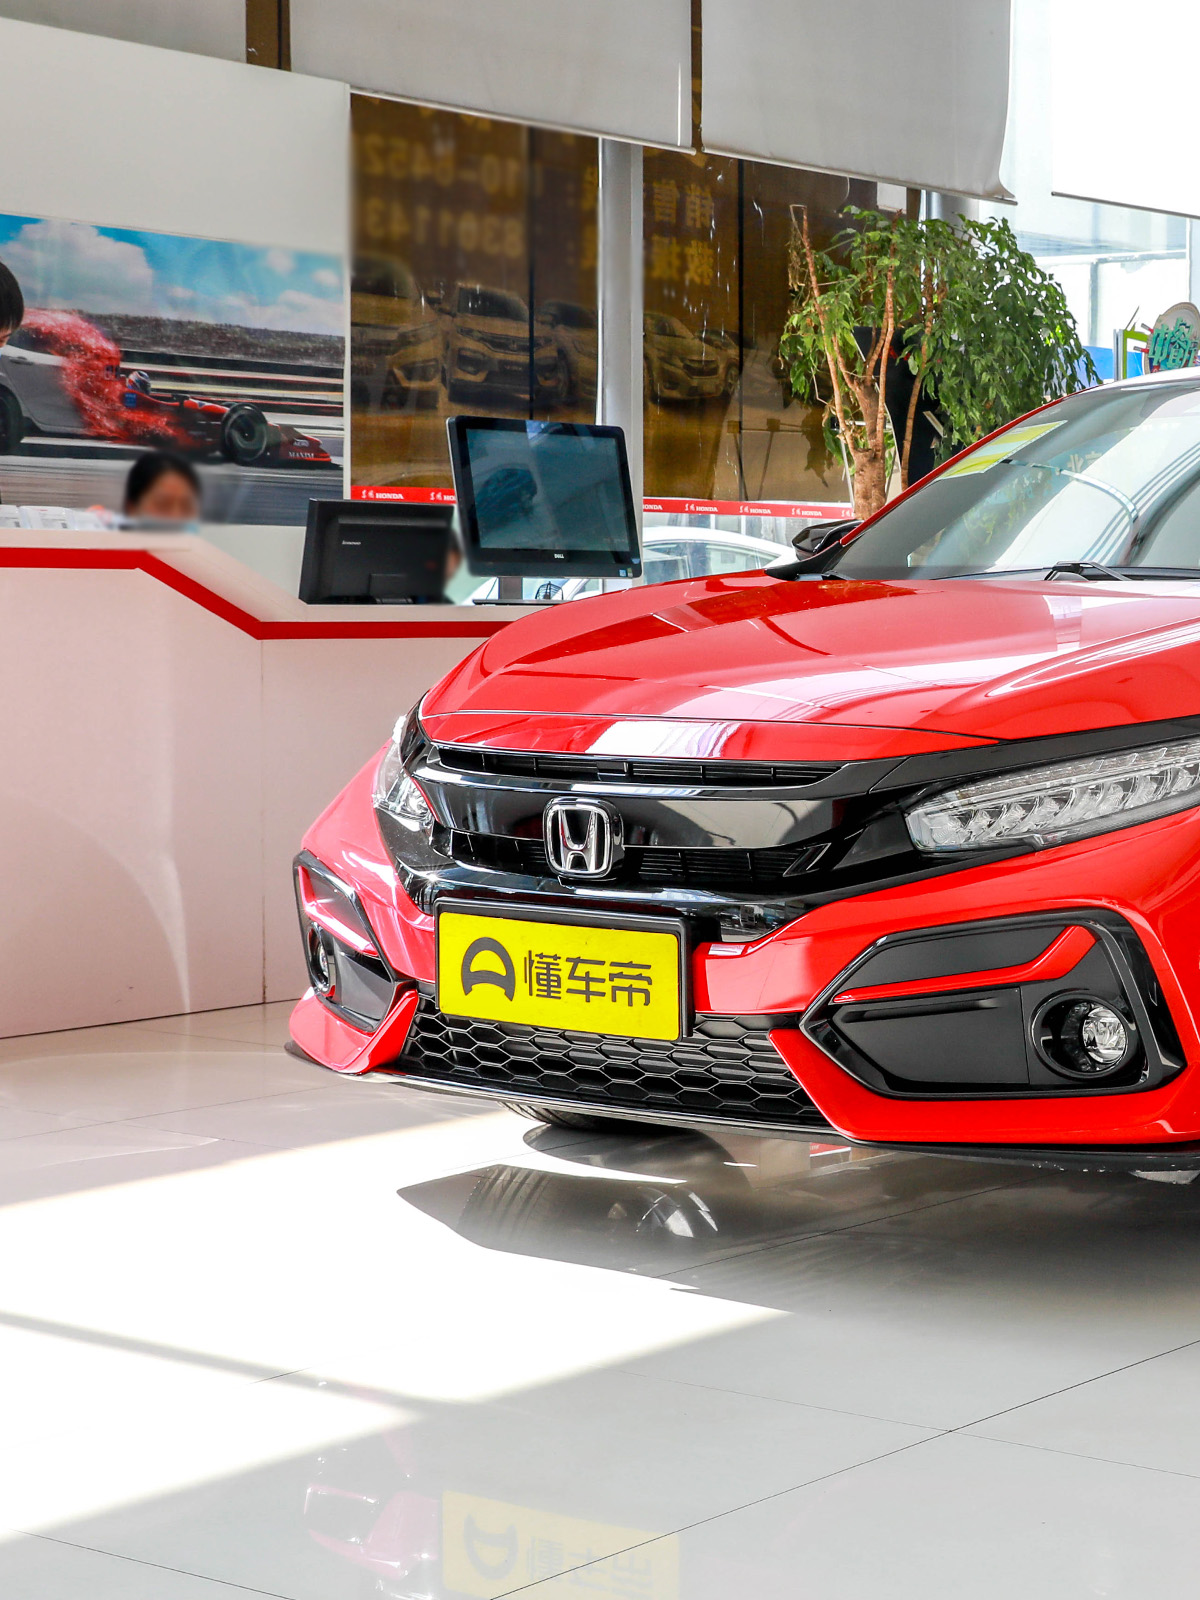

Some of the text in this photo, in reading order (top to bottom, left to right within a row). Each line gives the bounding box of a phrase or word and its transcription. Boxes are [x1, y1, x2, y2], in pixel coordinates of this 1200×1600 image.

[375, 492, 404, 500] HONDA
[696, 505, 718, 513] HONDA
[523, 949, 653, 1007] 懂车帝
